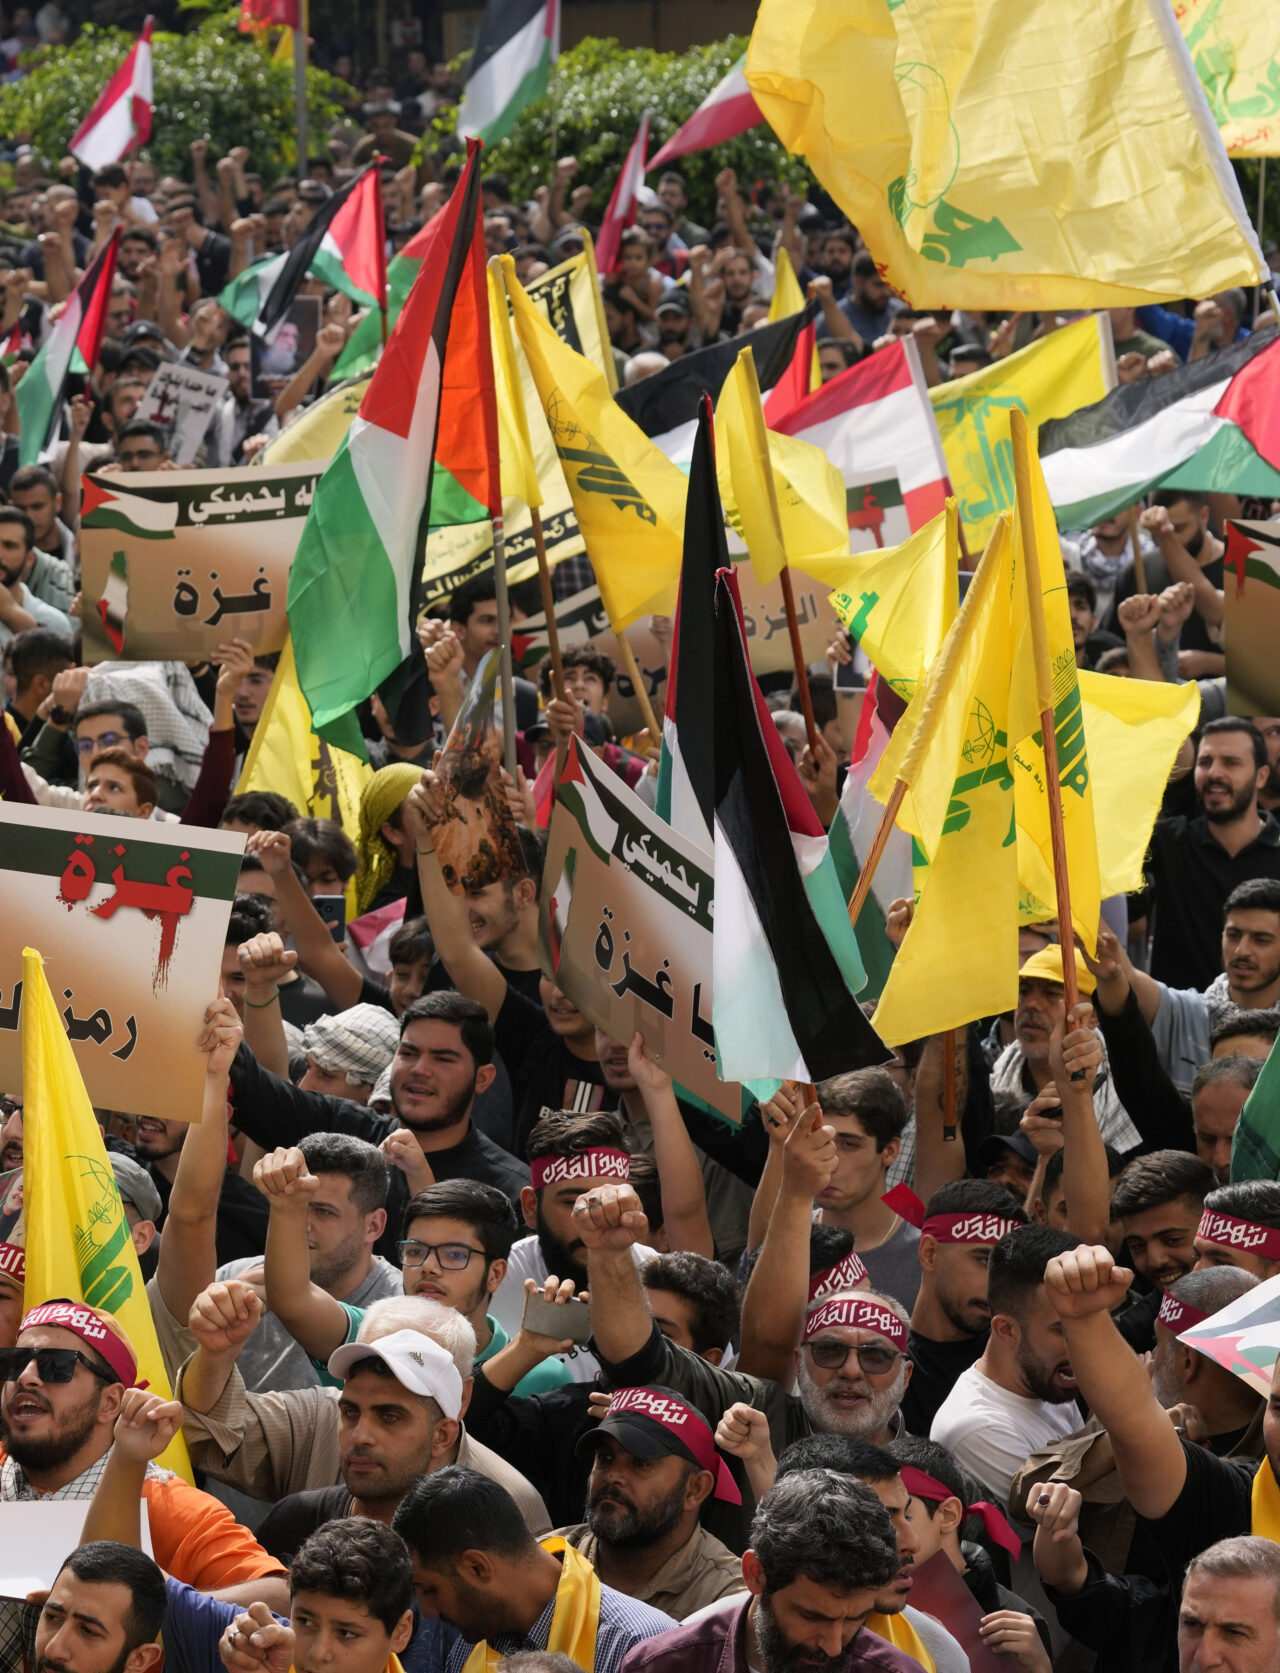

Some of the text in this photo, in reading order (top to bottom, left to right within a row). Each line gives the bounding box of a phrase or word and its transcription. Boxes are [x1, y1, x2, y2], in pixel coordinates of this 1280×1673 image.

[188, 484, 287, 528] يحميكي
[173, 566, 272, 627] غزة
[57, 833, 196, 932] غزة
[622, 832, 701, 916] يحميكي
[595, 905, 675, 1021] غزة
